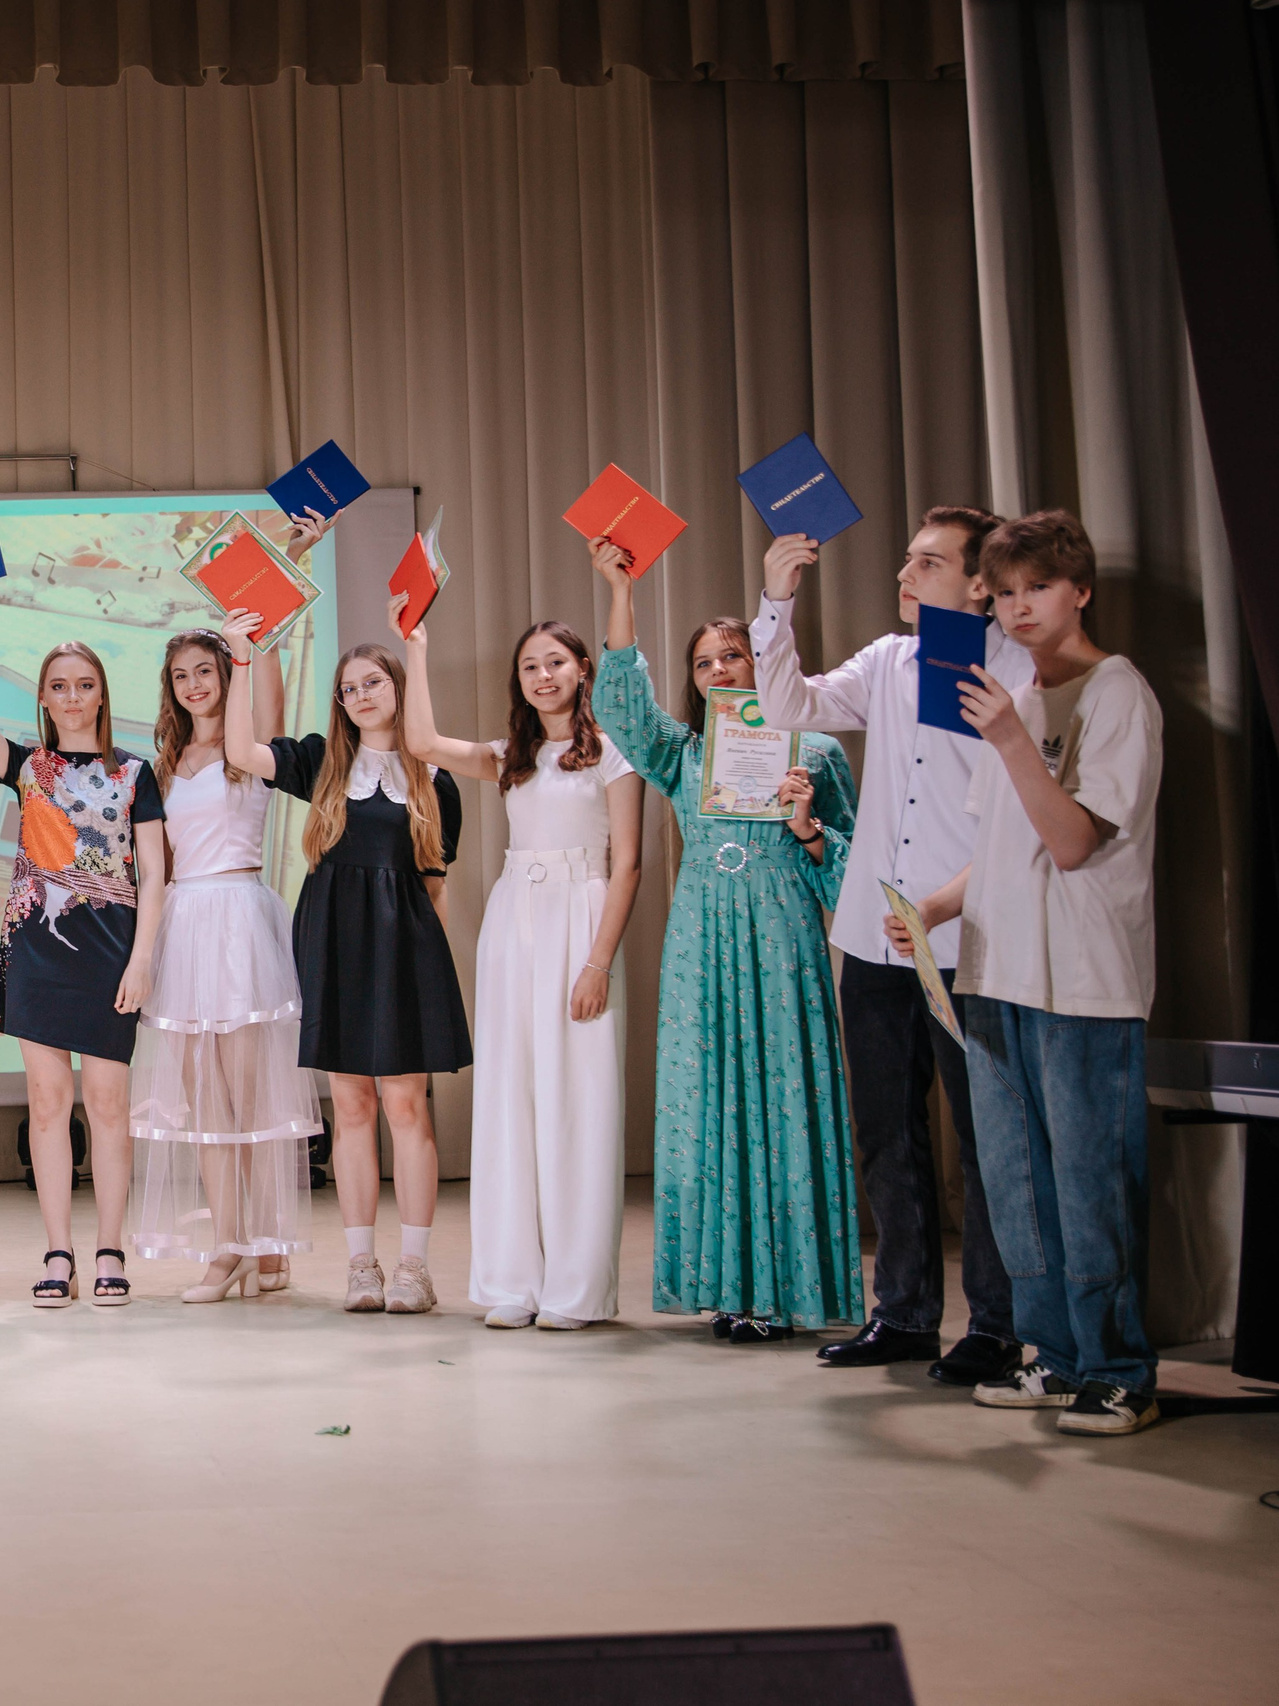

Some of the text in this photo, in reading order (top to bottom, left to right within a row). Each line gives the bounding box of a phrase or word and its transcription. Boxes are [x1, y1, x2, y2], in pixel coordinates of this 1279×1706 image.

[306, 467, 338, 504] СВИДЕТЕЛЬСТВО
[770, 472, 825, 511] СВИДЕТЕЛЬСТВО
[229, 567, 269, 600] СВИДЕТЕЛЬСТВО
[724, 728, 782, 741] ГРАМОТА
